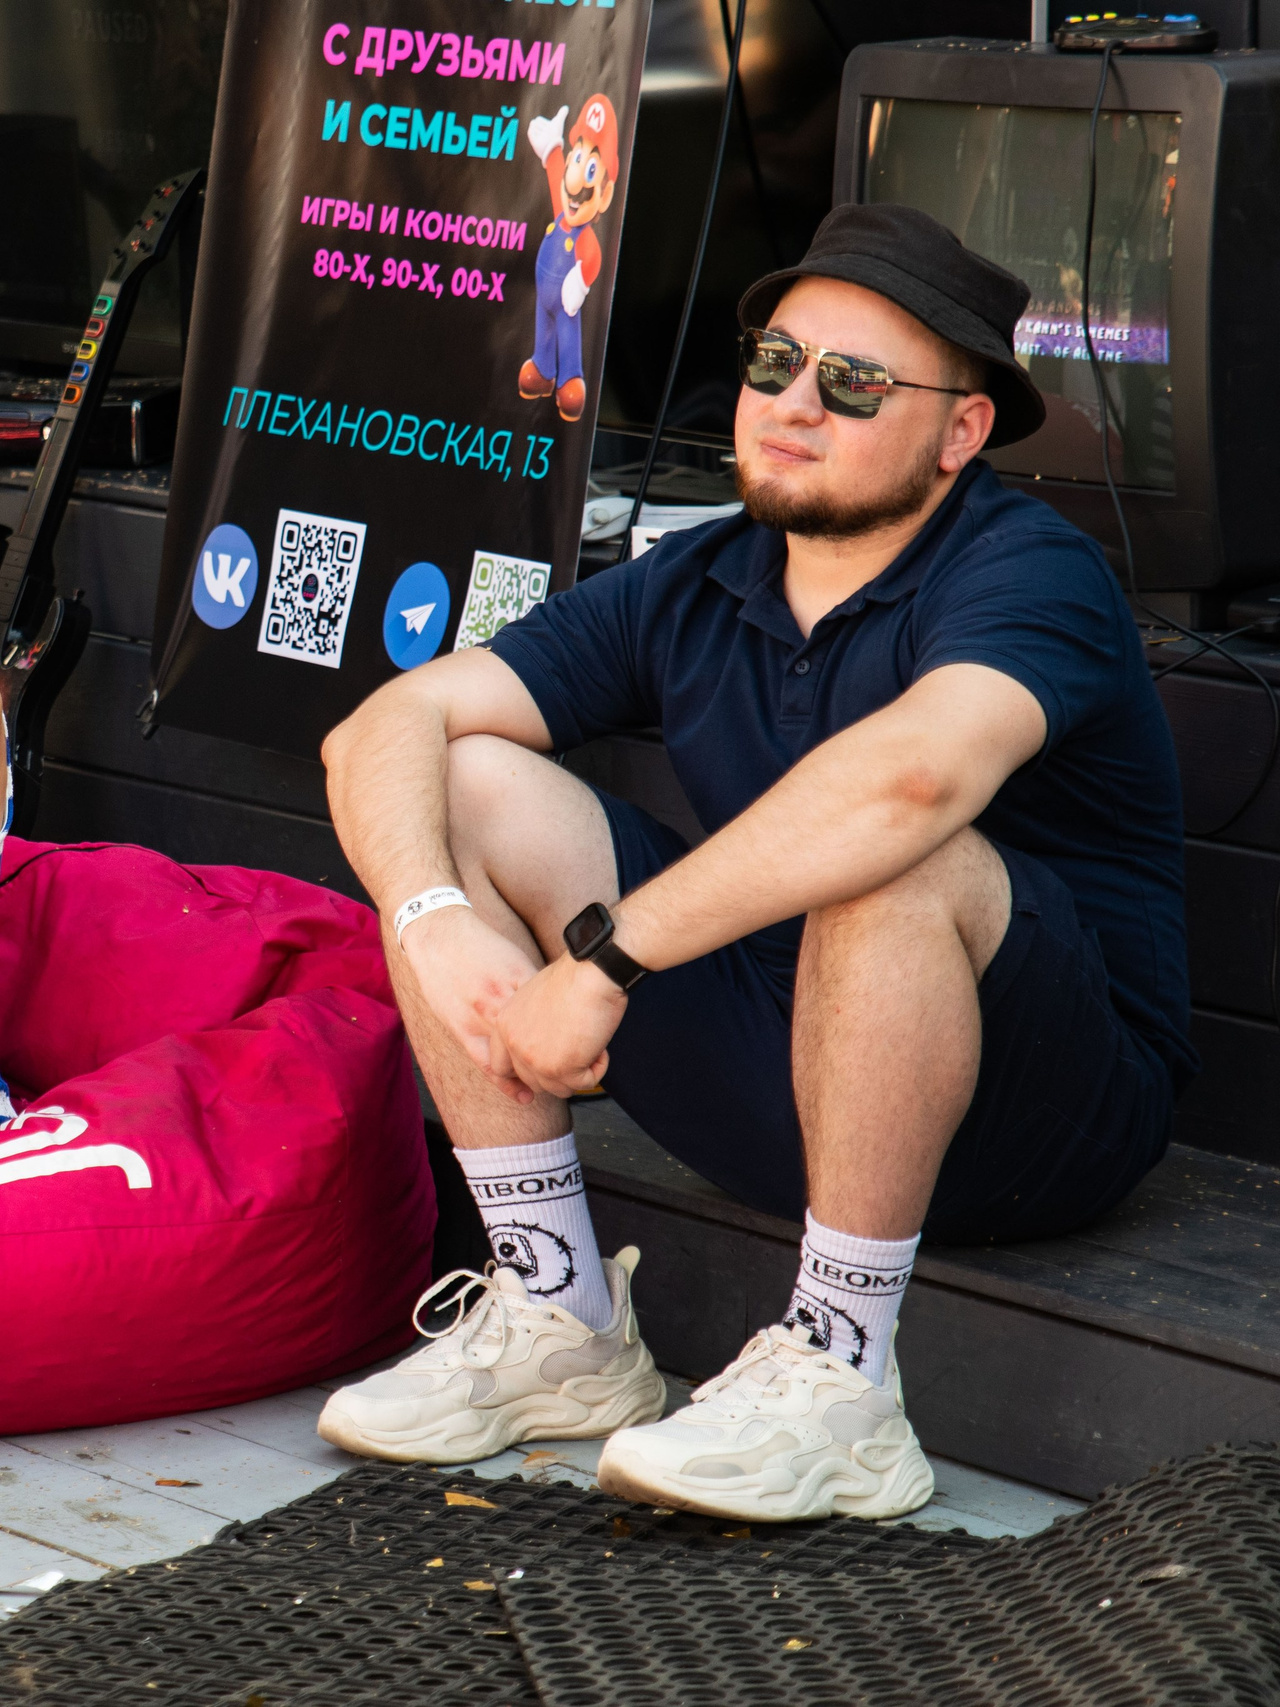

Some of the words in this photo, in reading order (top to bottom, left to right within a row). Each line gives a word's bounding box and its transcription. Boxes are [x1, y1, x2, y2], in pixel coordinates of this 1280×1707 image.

[70, 8, 149, 43] PAUSED
[323, 23, 349, 66] С
[355, 27, 566, 86] ДРУЗЬЯМИ
[321, 99, 350, 143] И
[359, 103, 519, 161] СЕМЬЕЙ
[300, 195, 375, 230] ИГРЫ
[378, 205, 399, 236] И
[404, 209, 527, 251] КОНСОЛИ
[313, 249, 375, 290] 80-Х,
[381, 257, 444, 299] 90-Х,
[1098, 349, 1124, 363] THE
[223, 386, 512, 482] ПЛЕХАНОВСКАЯ,
[522, 435, 555, 480] 13
